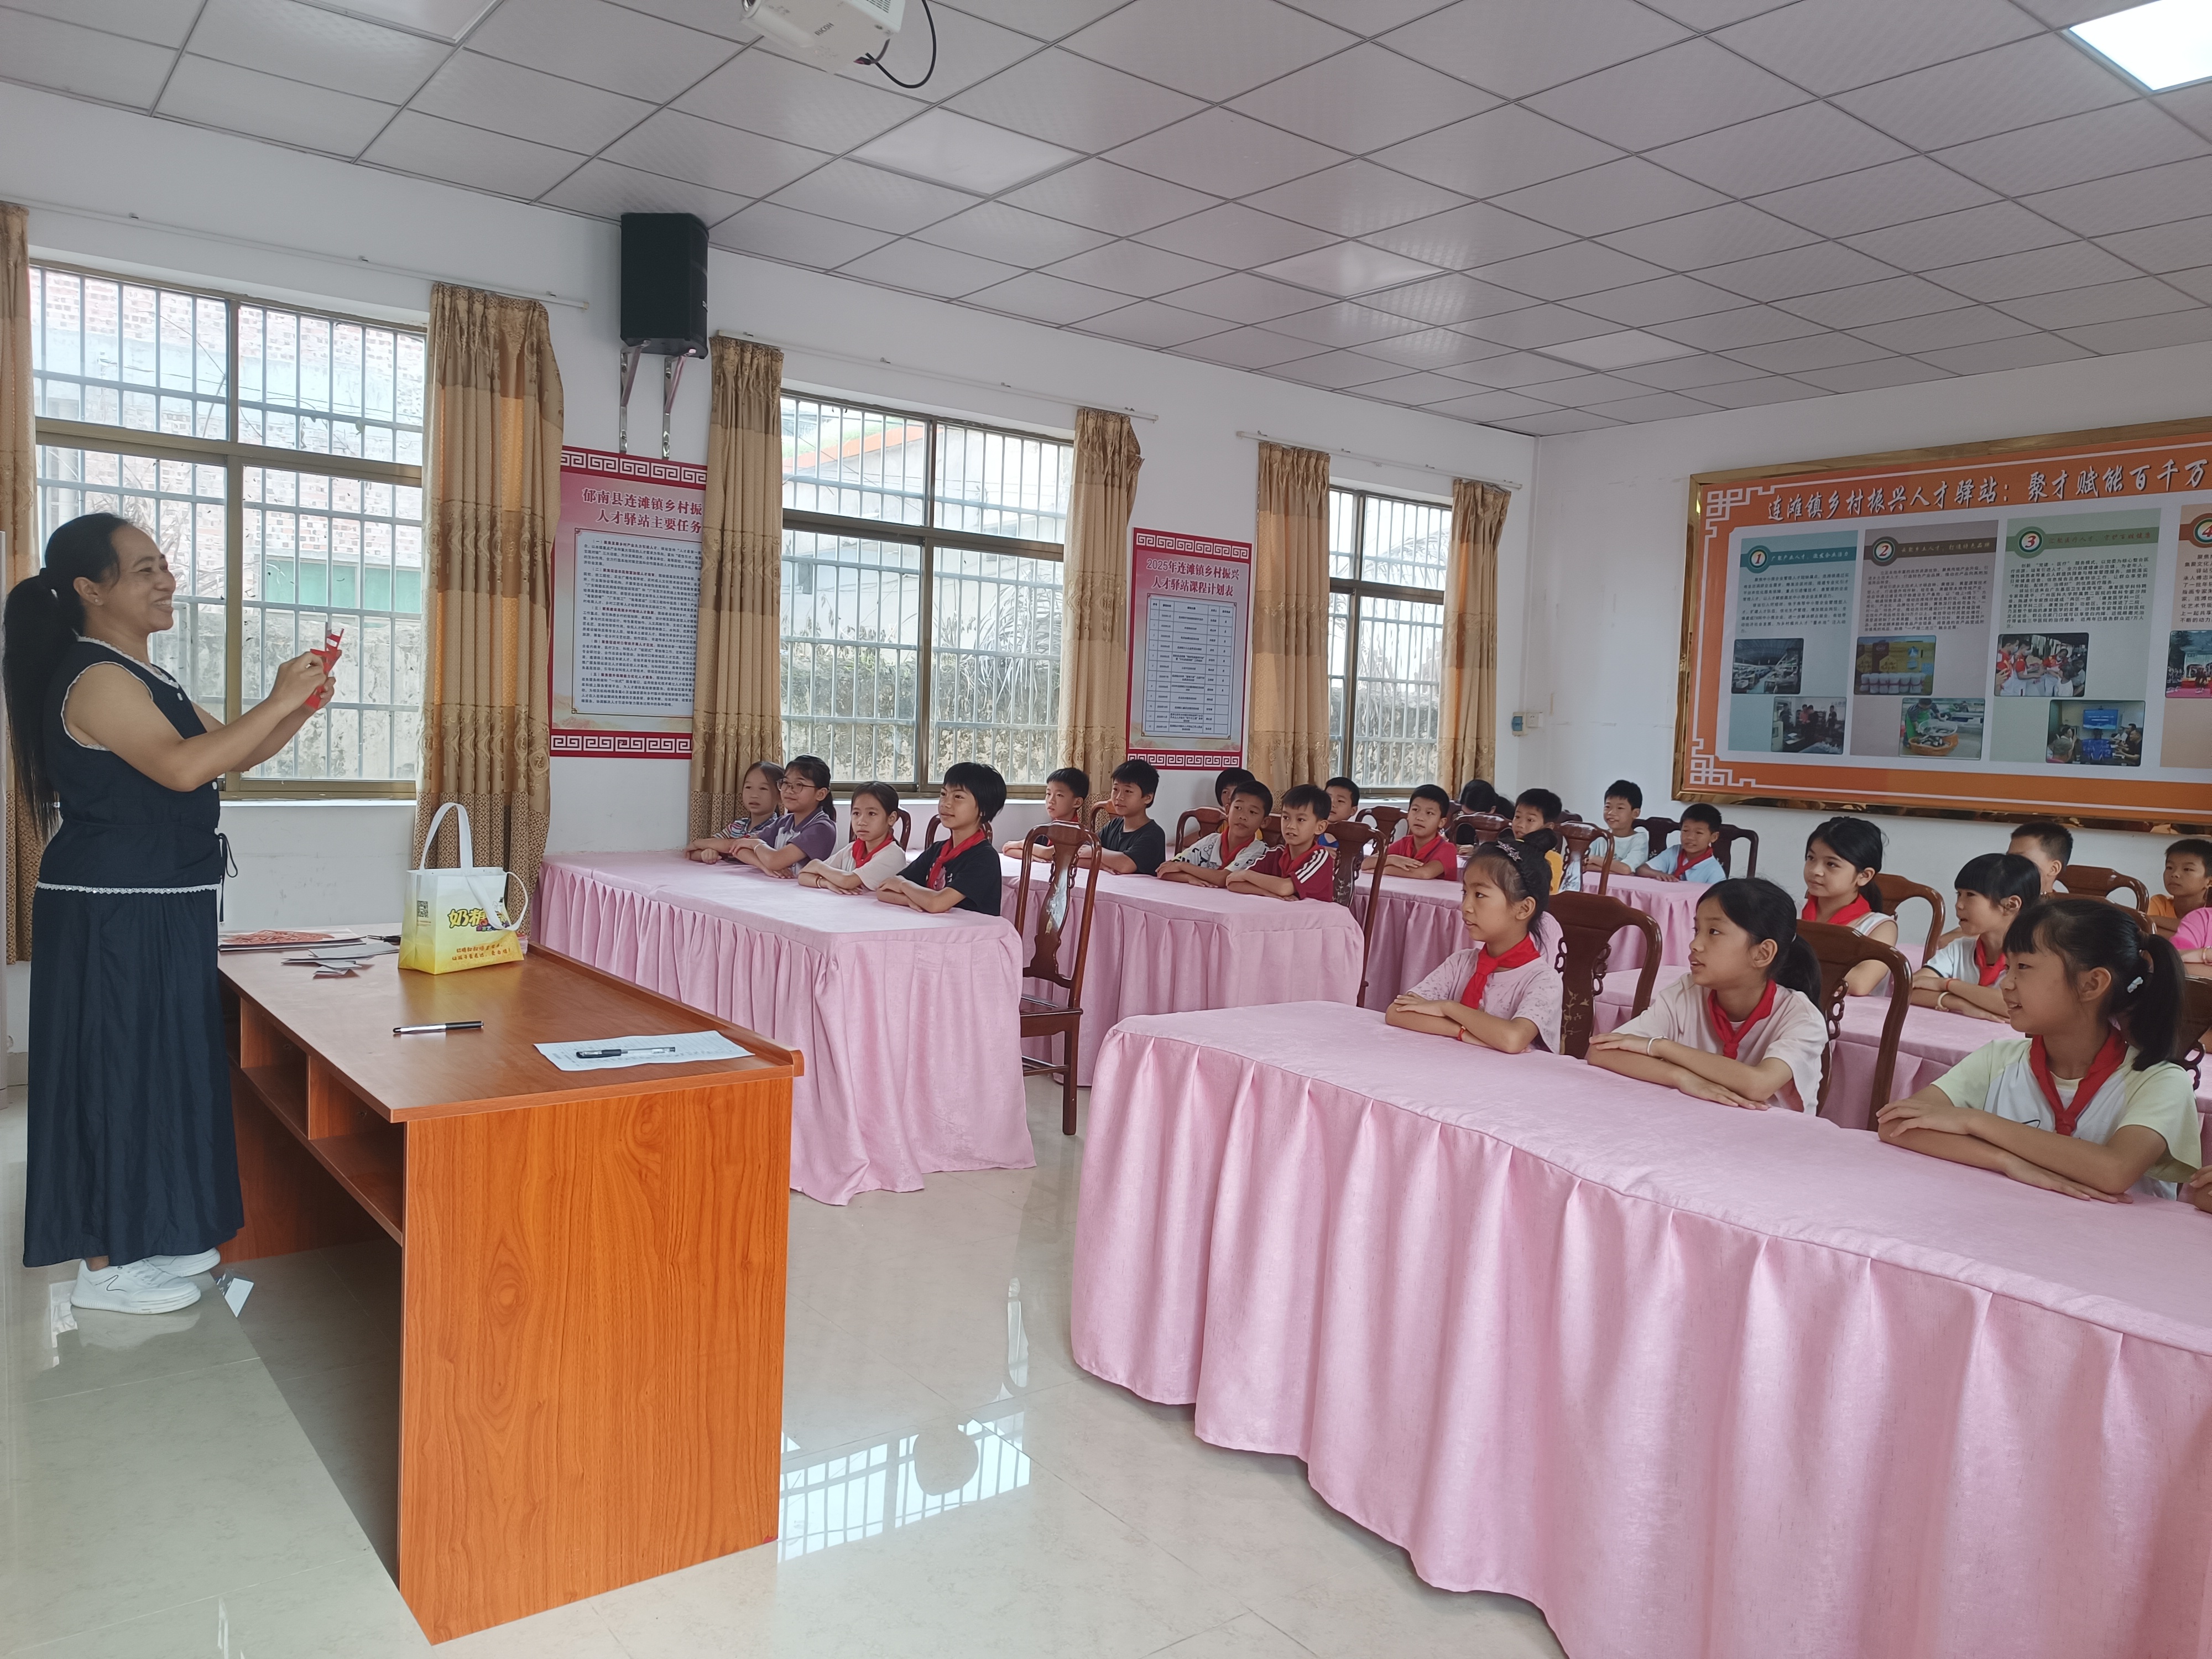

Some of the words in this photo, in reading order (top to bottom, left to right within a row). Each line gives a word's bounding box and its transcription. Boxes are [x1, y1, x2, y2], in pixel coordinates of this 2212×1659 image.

[813, 22, 834, 36] RICOH
[583, 488, 702, 515] 郁南县连滩镇乡村振
[596, 509, 702, 534] 人才驿站主要任务
[2025, 535, 2036, 548] 3
[1755, 554, 1761, 564] 1
[1879, 545, 1889, 556] 2
[1147, 559, 1240, 580] 2025年连滩镇乡村振兴
[1151, 576, 1234, 597] 人才驿站课程计划表
